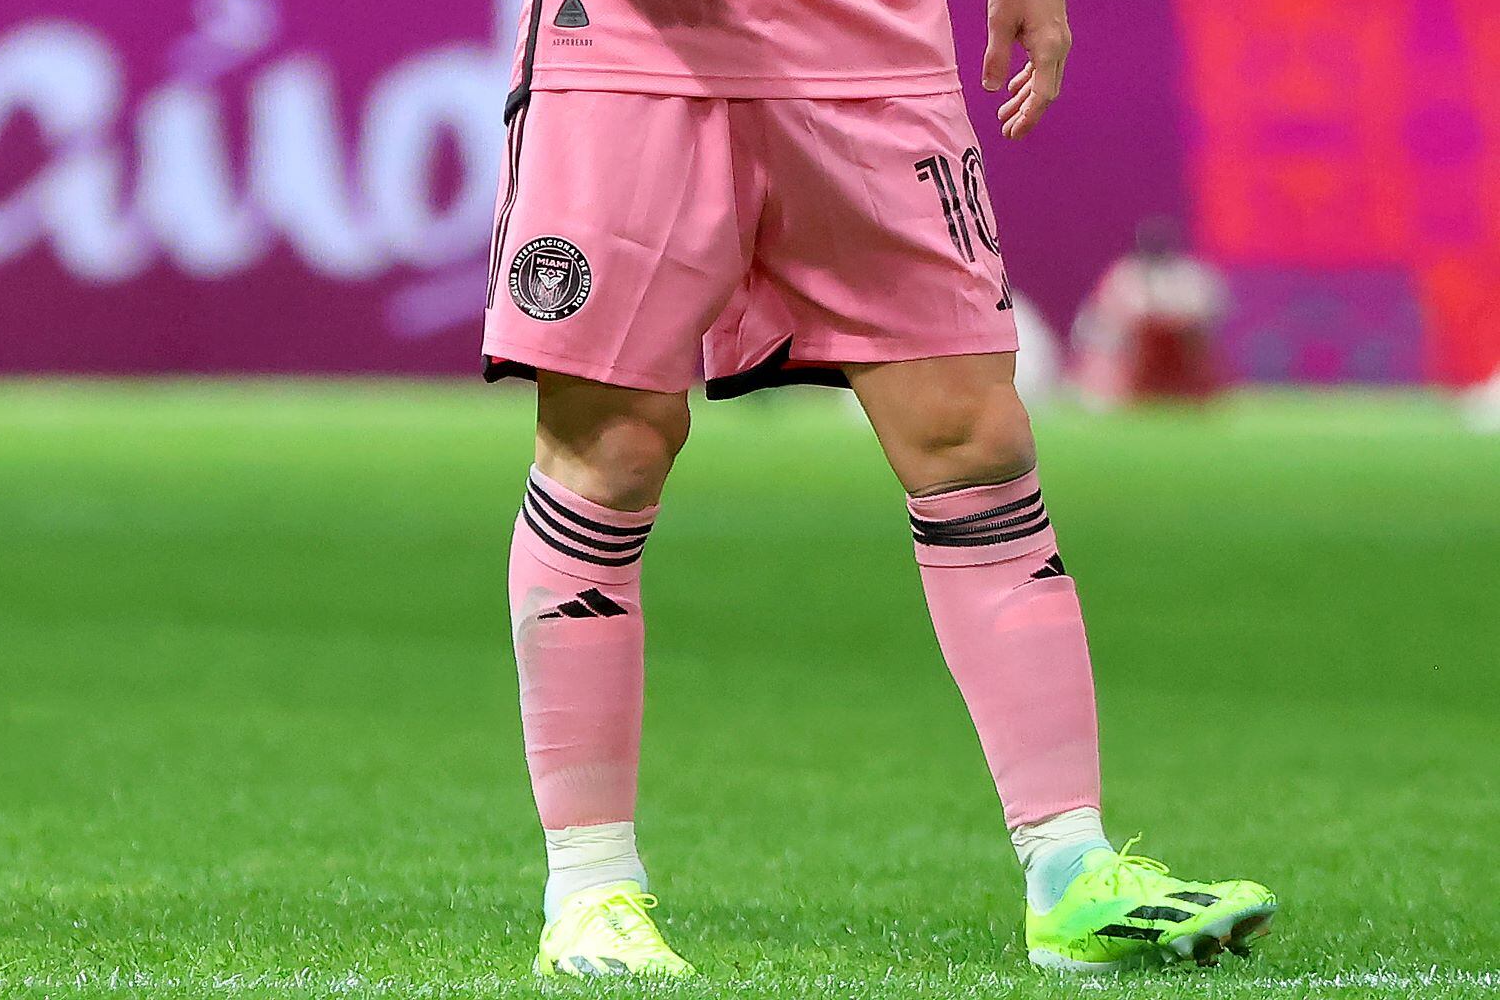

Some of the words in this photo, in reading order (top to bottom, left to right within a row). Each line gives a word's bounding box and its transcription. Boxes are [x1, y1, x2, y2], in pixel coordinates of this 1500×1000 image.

[512, 238, 580, 270] INTERNACIONAL
[536, 256, 570, 270] MIAMI
[509, 272, 520, 297] CLUB
